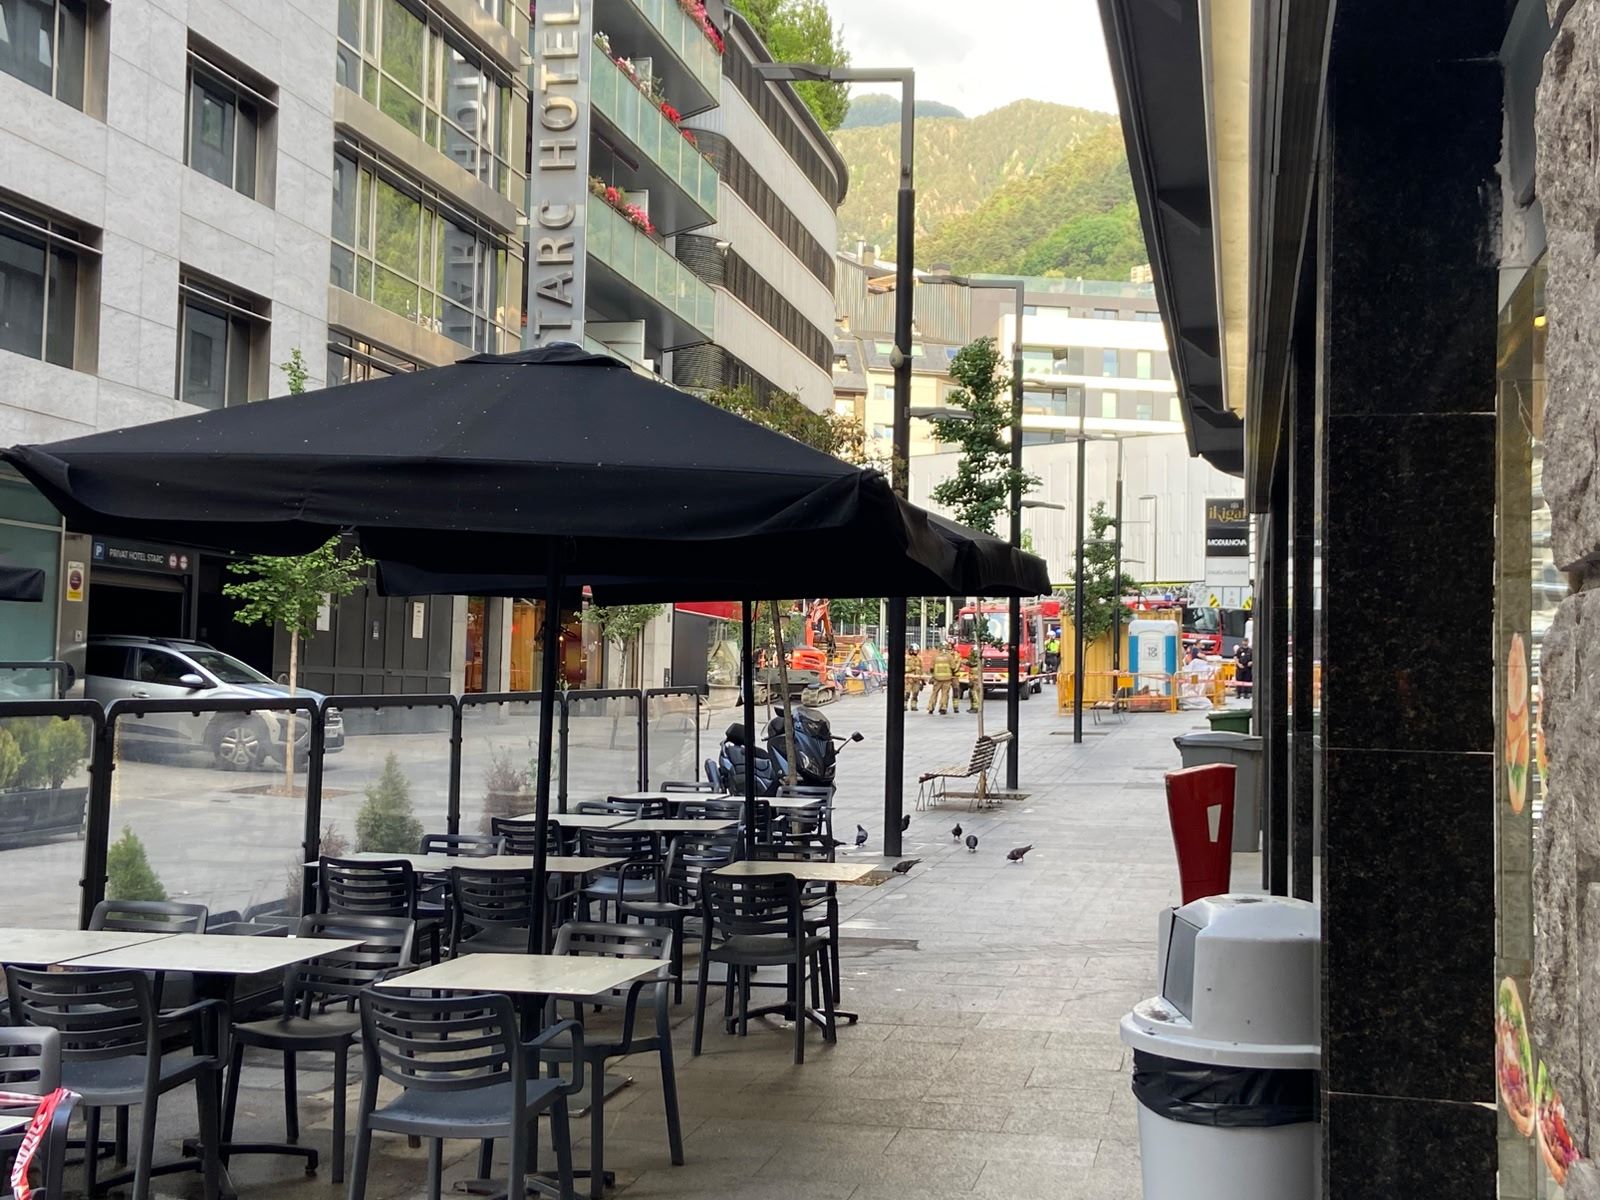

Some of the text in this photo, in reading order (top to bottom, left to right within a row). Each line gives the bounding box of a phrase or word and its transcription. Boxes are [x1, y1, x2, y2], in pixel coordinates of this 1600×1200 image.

[535, 0, 581, 341] TARC HOTEL
[96, 545, 102, 556] P
[109, 548, 164, 564] PRIVAT HOTEL STARC
